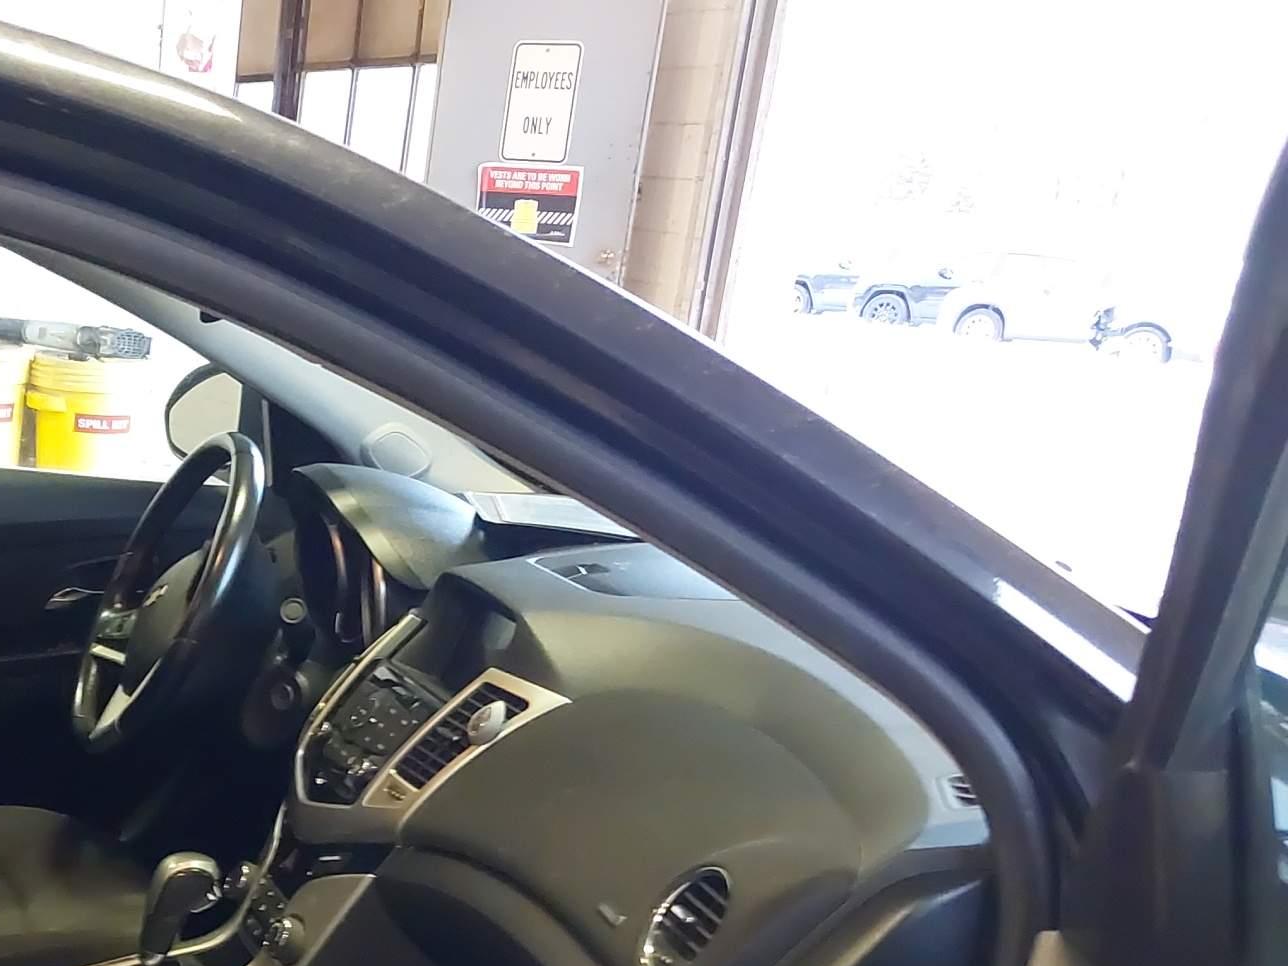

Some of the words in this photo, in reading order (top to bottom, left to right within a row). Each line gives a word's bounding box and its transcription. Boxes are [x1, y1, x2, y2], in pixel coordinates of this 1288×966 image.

[515, 71, 573, 90] EMPLOYEES
[523, 116, 552, 134] ONLY
[512, 171, 527, 180] ARE
[527, 173, 537, 181] TO
[495, 179, 524, 189] BEYOND
[524, 181, 541, 190] THIS
[541, 182, 563, 191] POINT
[77, 418, 110, 430] SPILL
